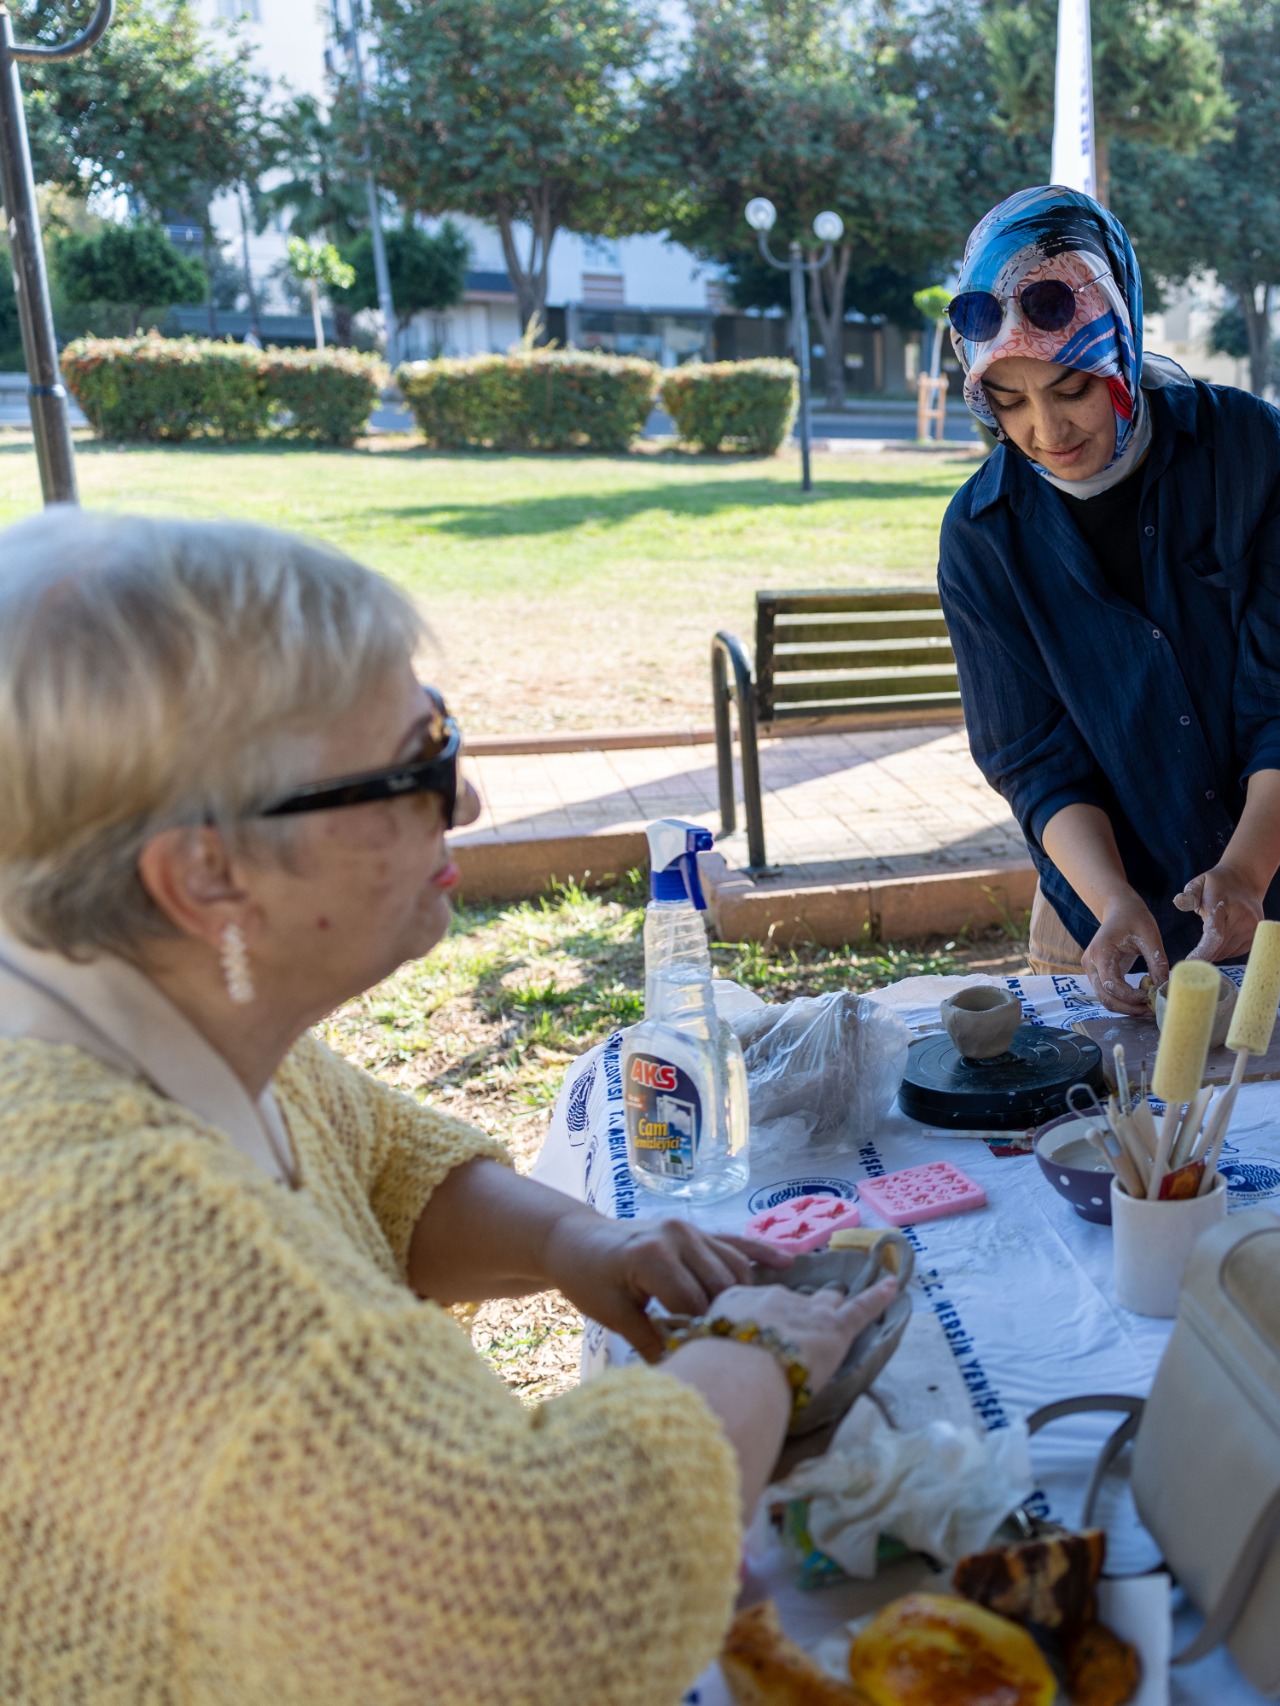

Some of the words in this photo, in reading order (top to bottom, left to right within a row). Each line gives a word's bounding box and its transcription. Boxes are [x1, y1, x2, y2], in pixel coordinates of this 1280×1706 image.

[631, 1058, 677, 1092] AKS
[638, 1118, 667, 1137] Cam
[932, 1300, 975, 1357] MERSİN
